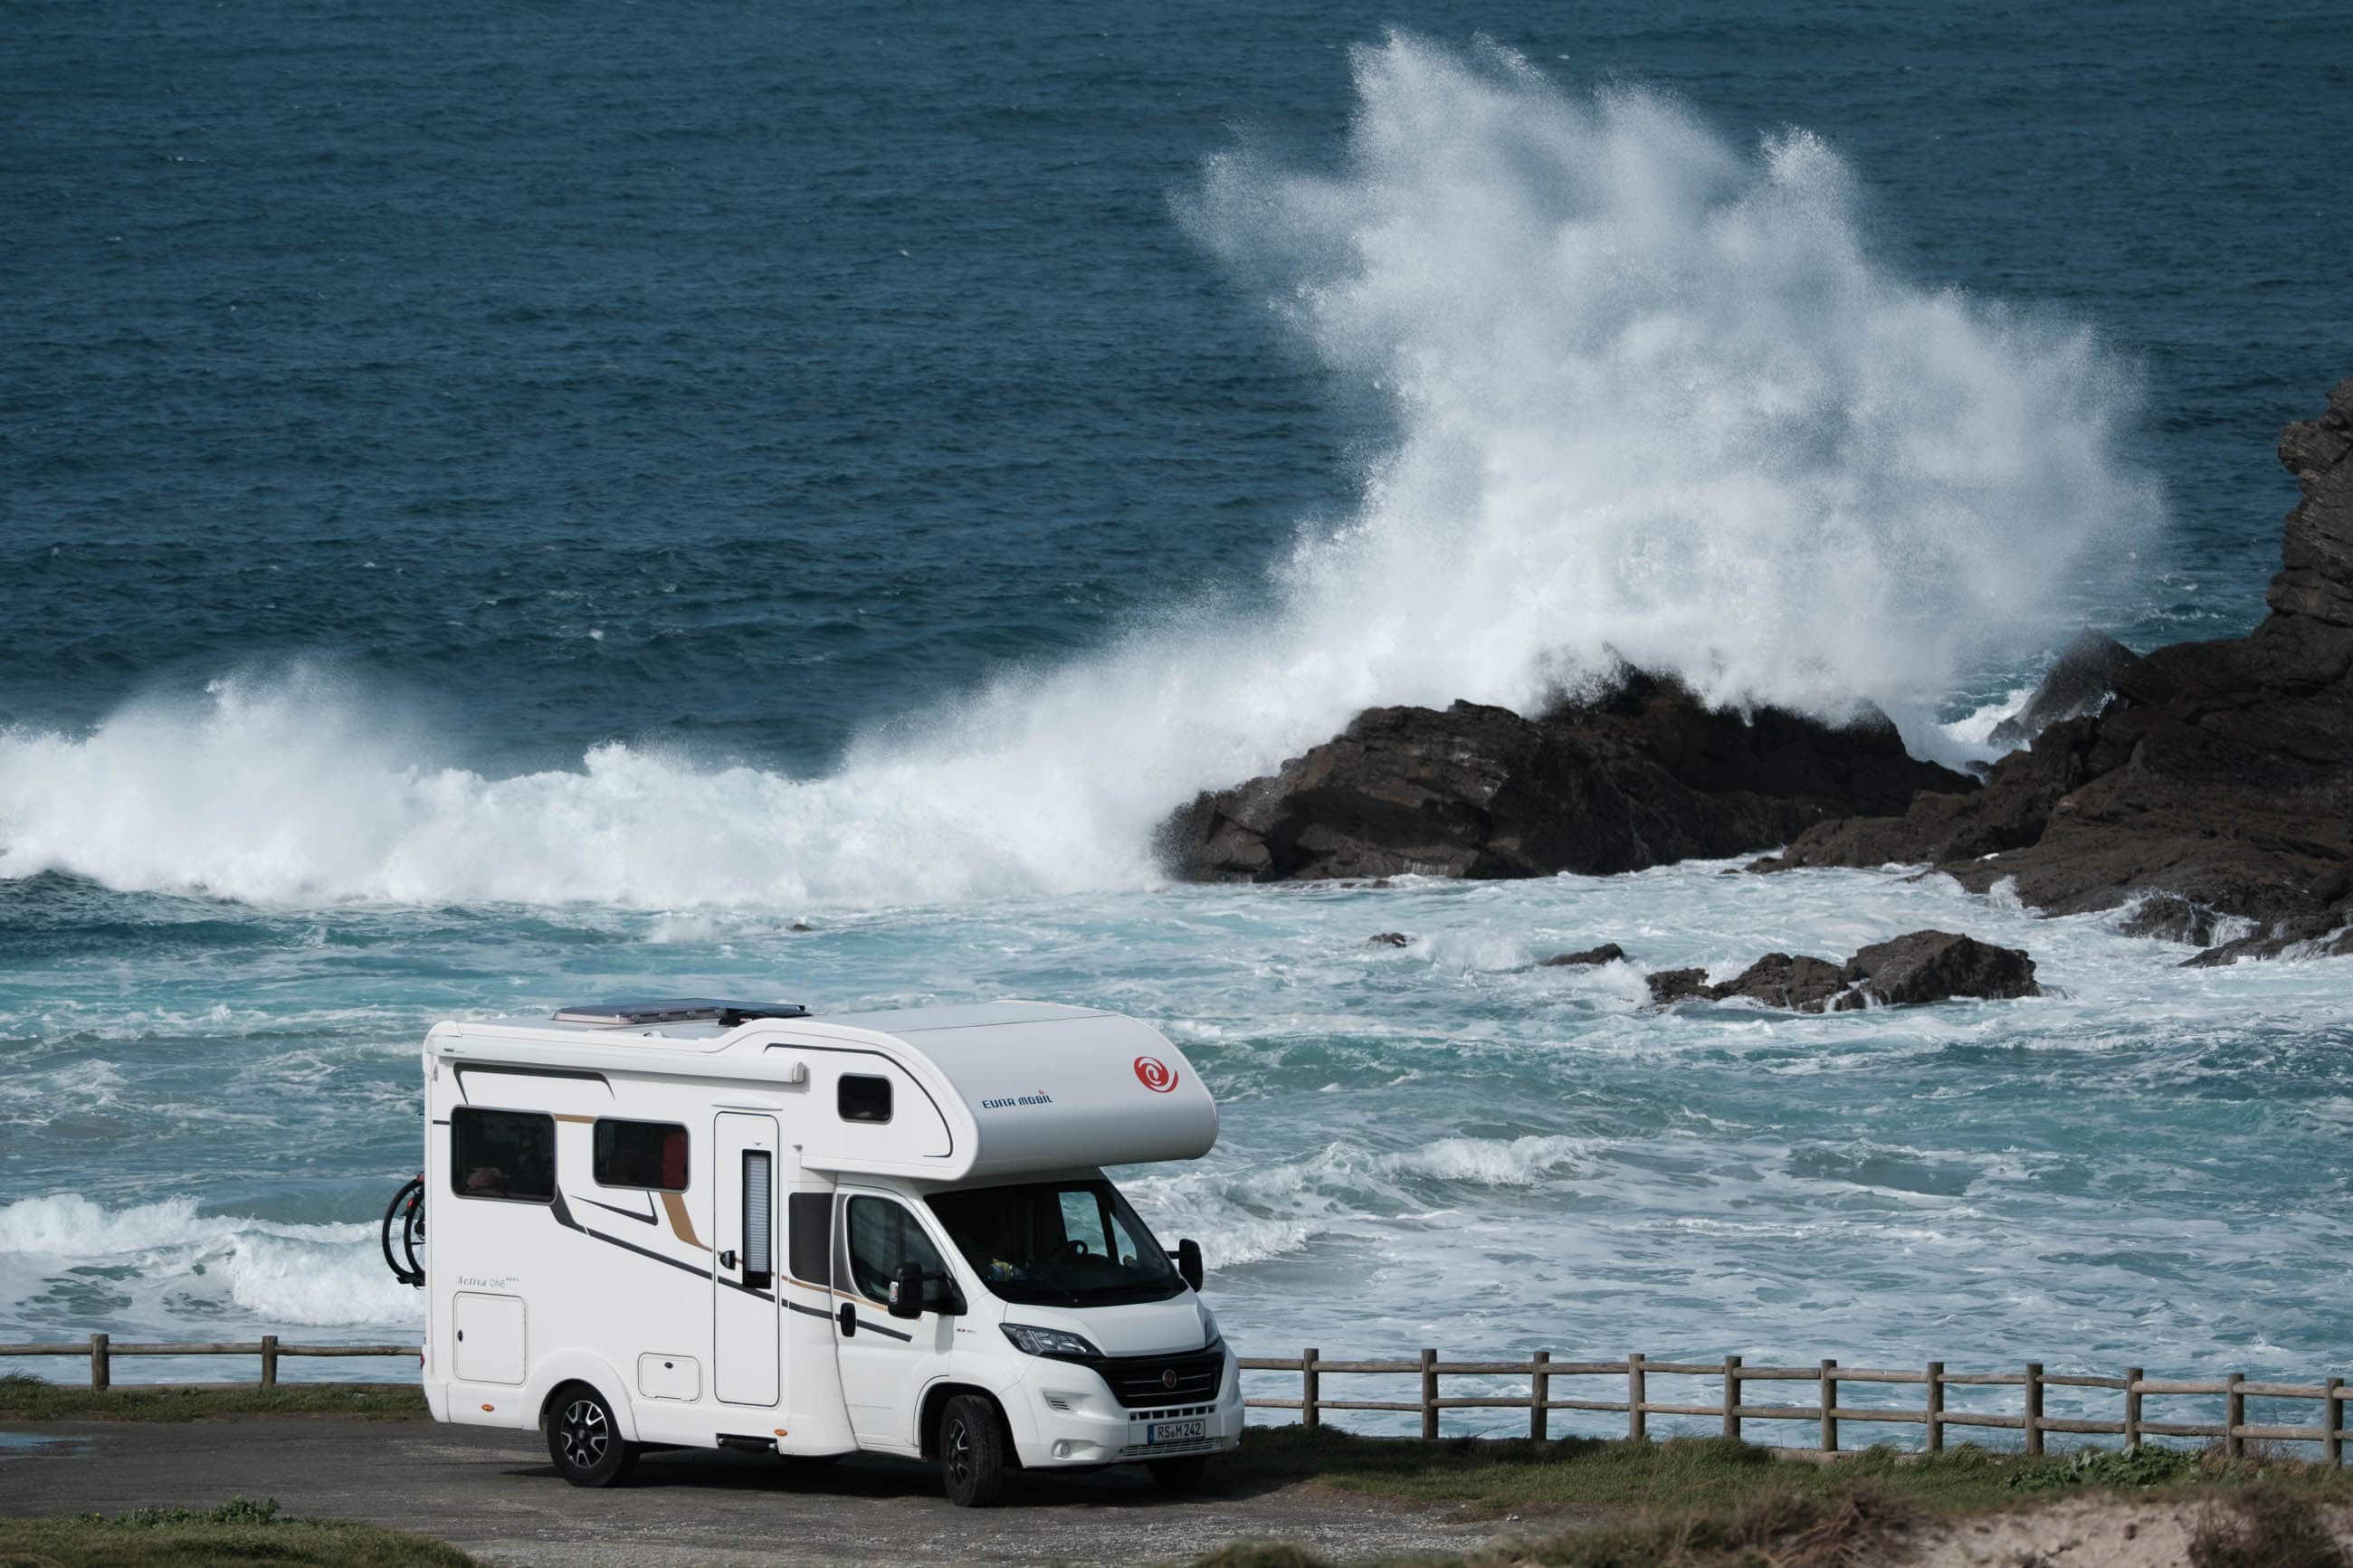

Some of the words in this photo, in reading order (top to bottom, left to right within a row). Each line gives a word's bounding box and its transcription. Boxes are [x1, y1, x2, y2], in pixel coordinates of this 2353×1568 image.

[1158, 1426, 1170, 1439] RS
[1176, 1424, 1182, 1437] M
[1184, 1422, 1201, 1436] 242
